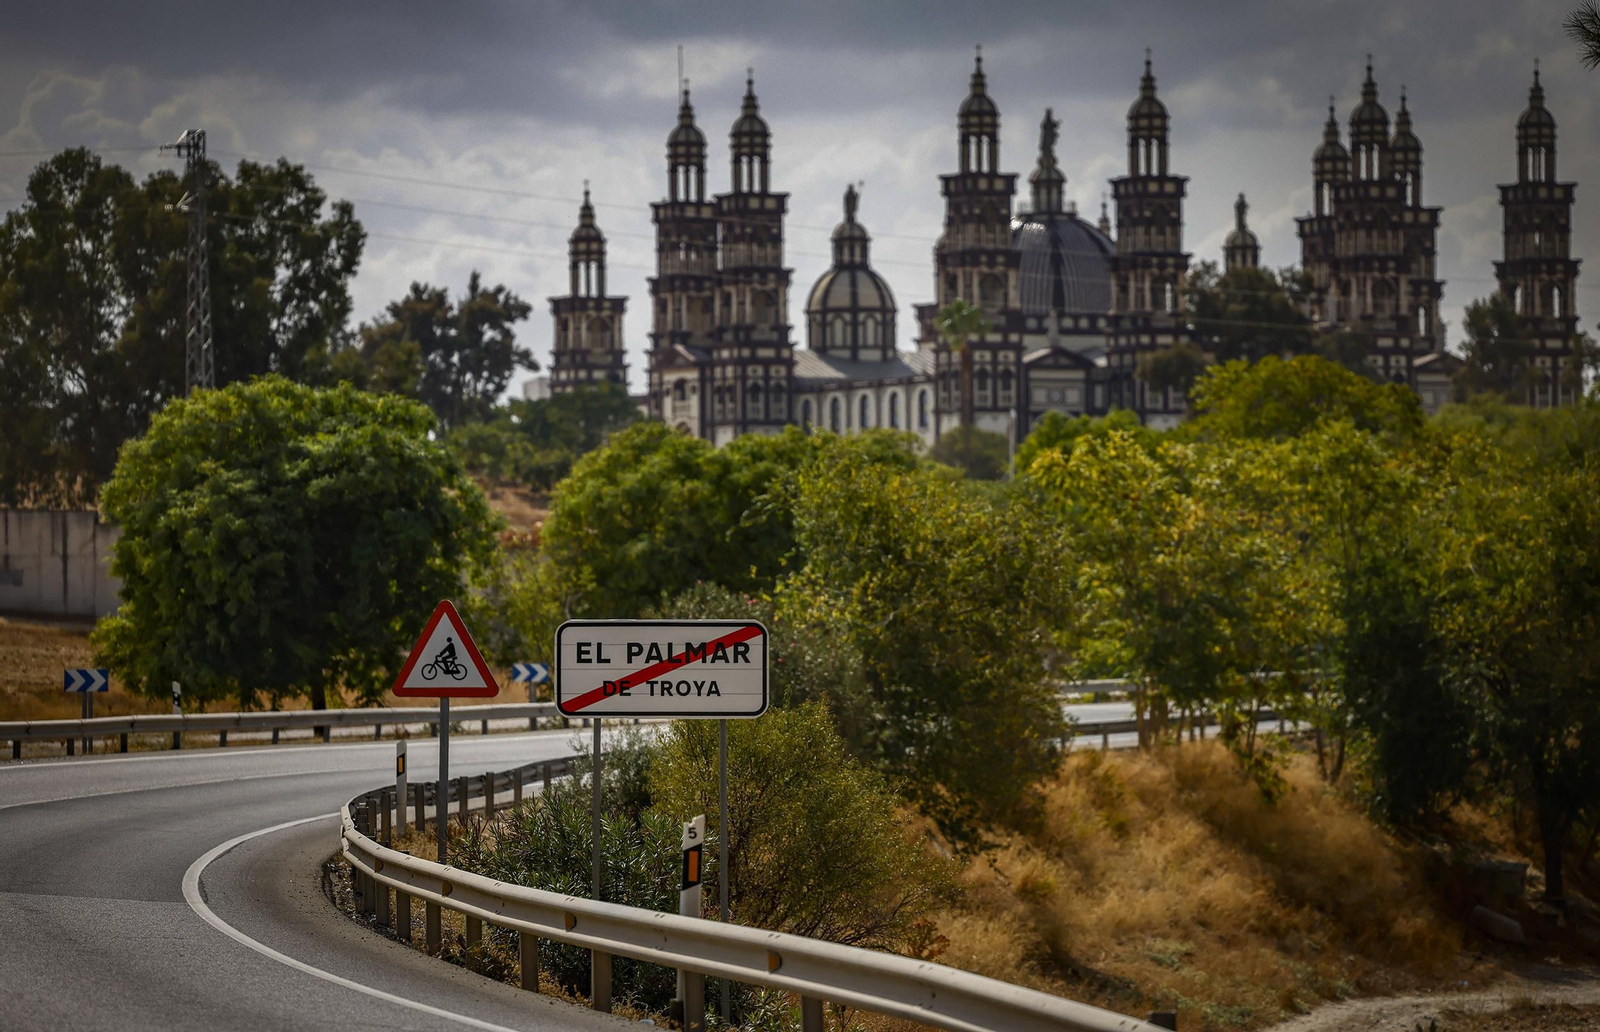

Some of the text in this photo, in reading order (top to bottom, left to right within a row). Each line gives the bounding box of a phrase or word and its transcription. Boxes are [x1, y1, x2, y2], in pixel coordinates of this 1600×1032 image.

[576, 642, 751, 664] EL PALMAR
[602, 680, 721, 697] DE TROYA
[688, 827, 697, 839] 5
